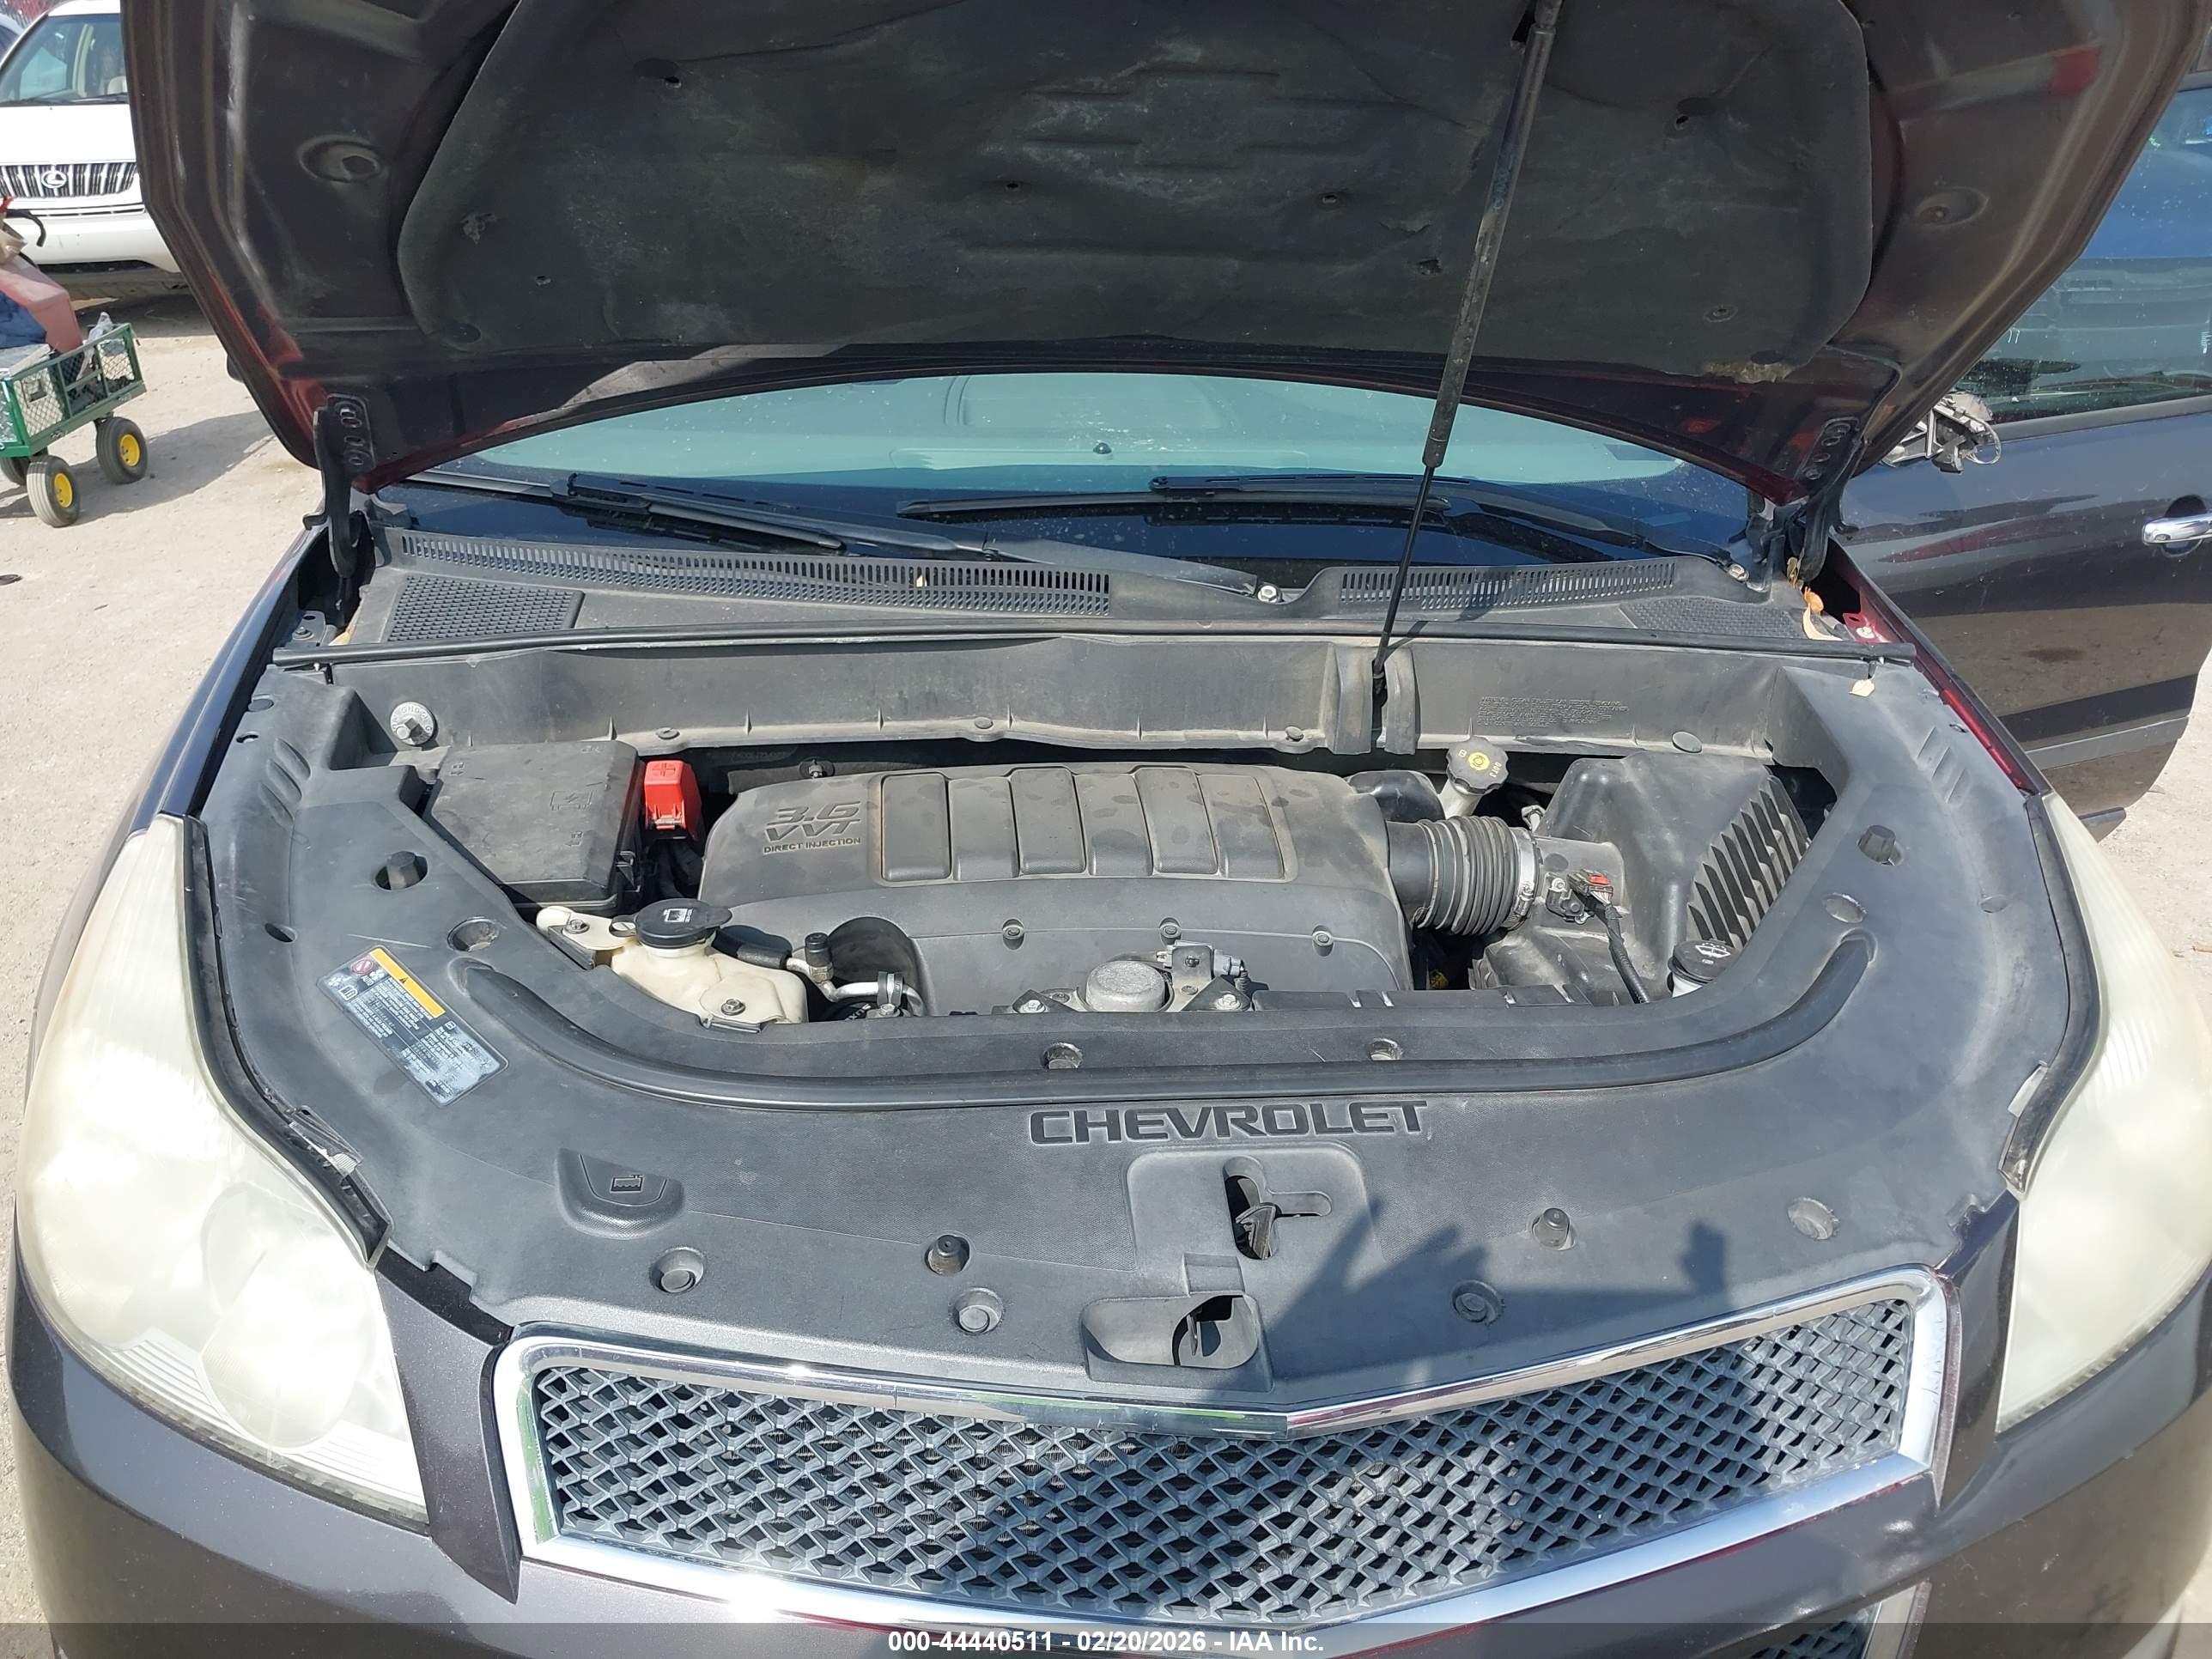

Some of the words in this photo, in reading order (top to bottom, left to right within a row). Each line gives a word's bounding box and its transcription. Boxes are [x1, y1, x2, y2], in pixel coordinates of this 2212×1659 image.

[767, 800, 861, 826] 3.6
[764, 818, 861, 842] VVT
[763, 842, 804, 854] DIRECT
[805, 836, 861, 849] INJECTION
[1029, 1100, 1428, 1145] CHEVROLET
